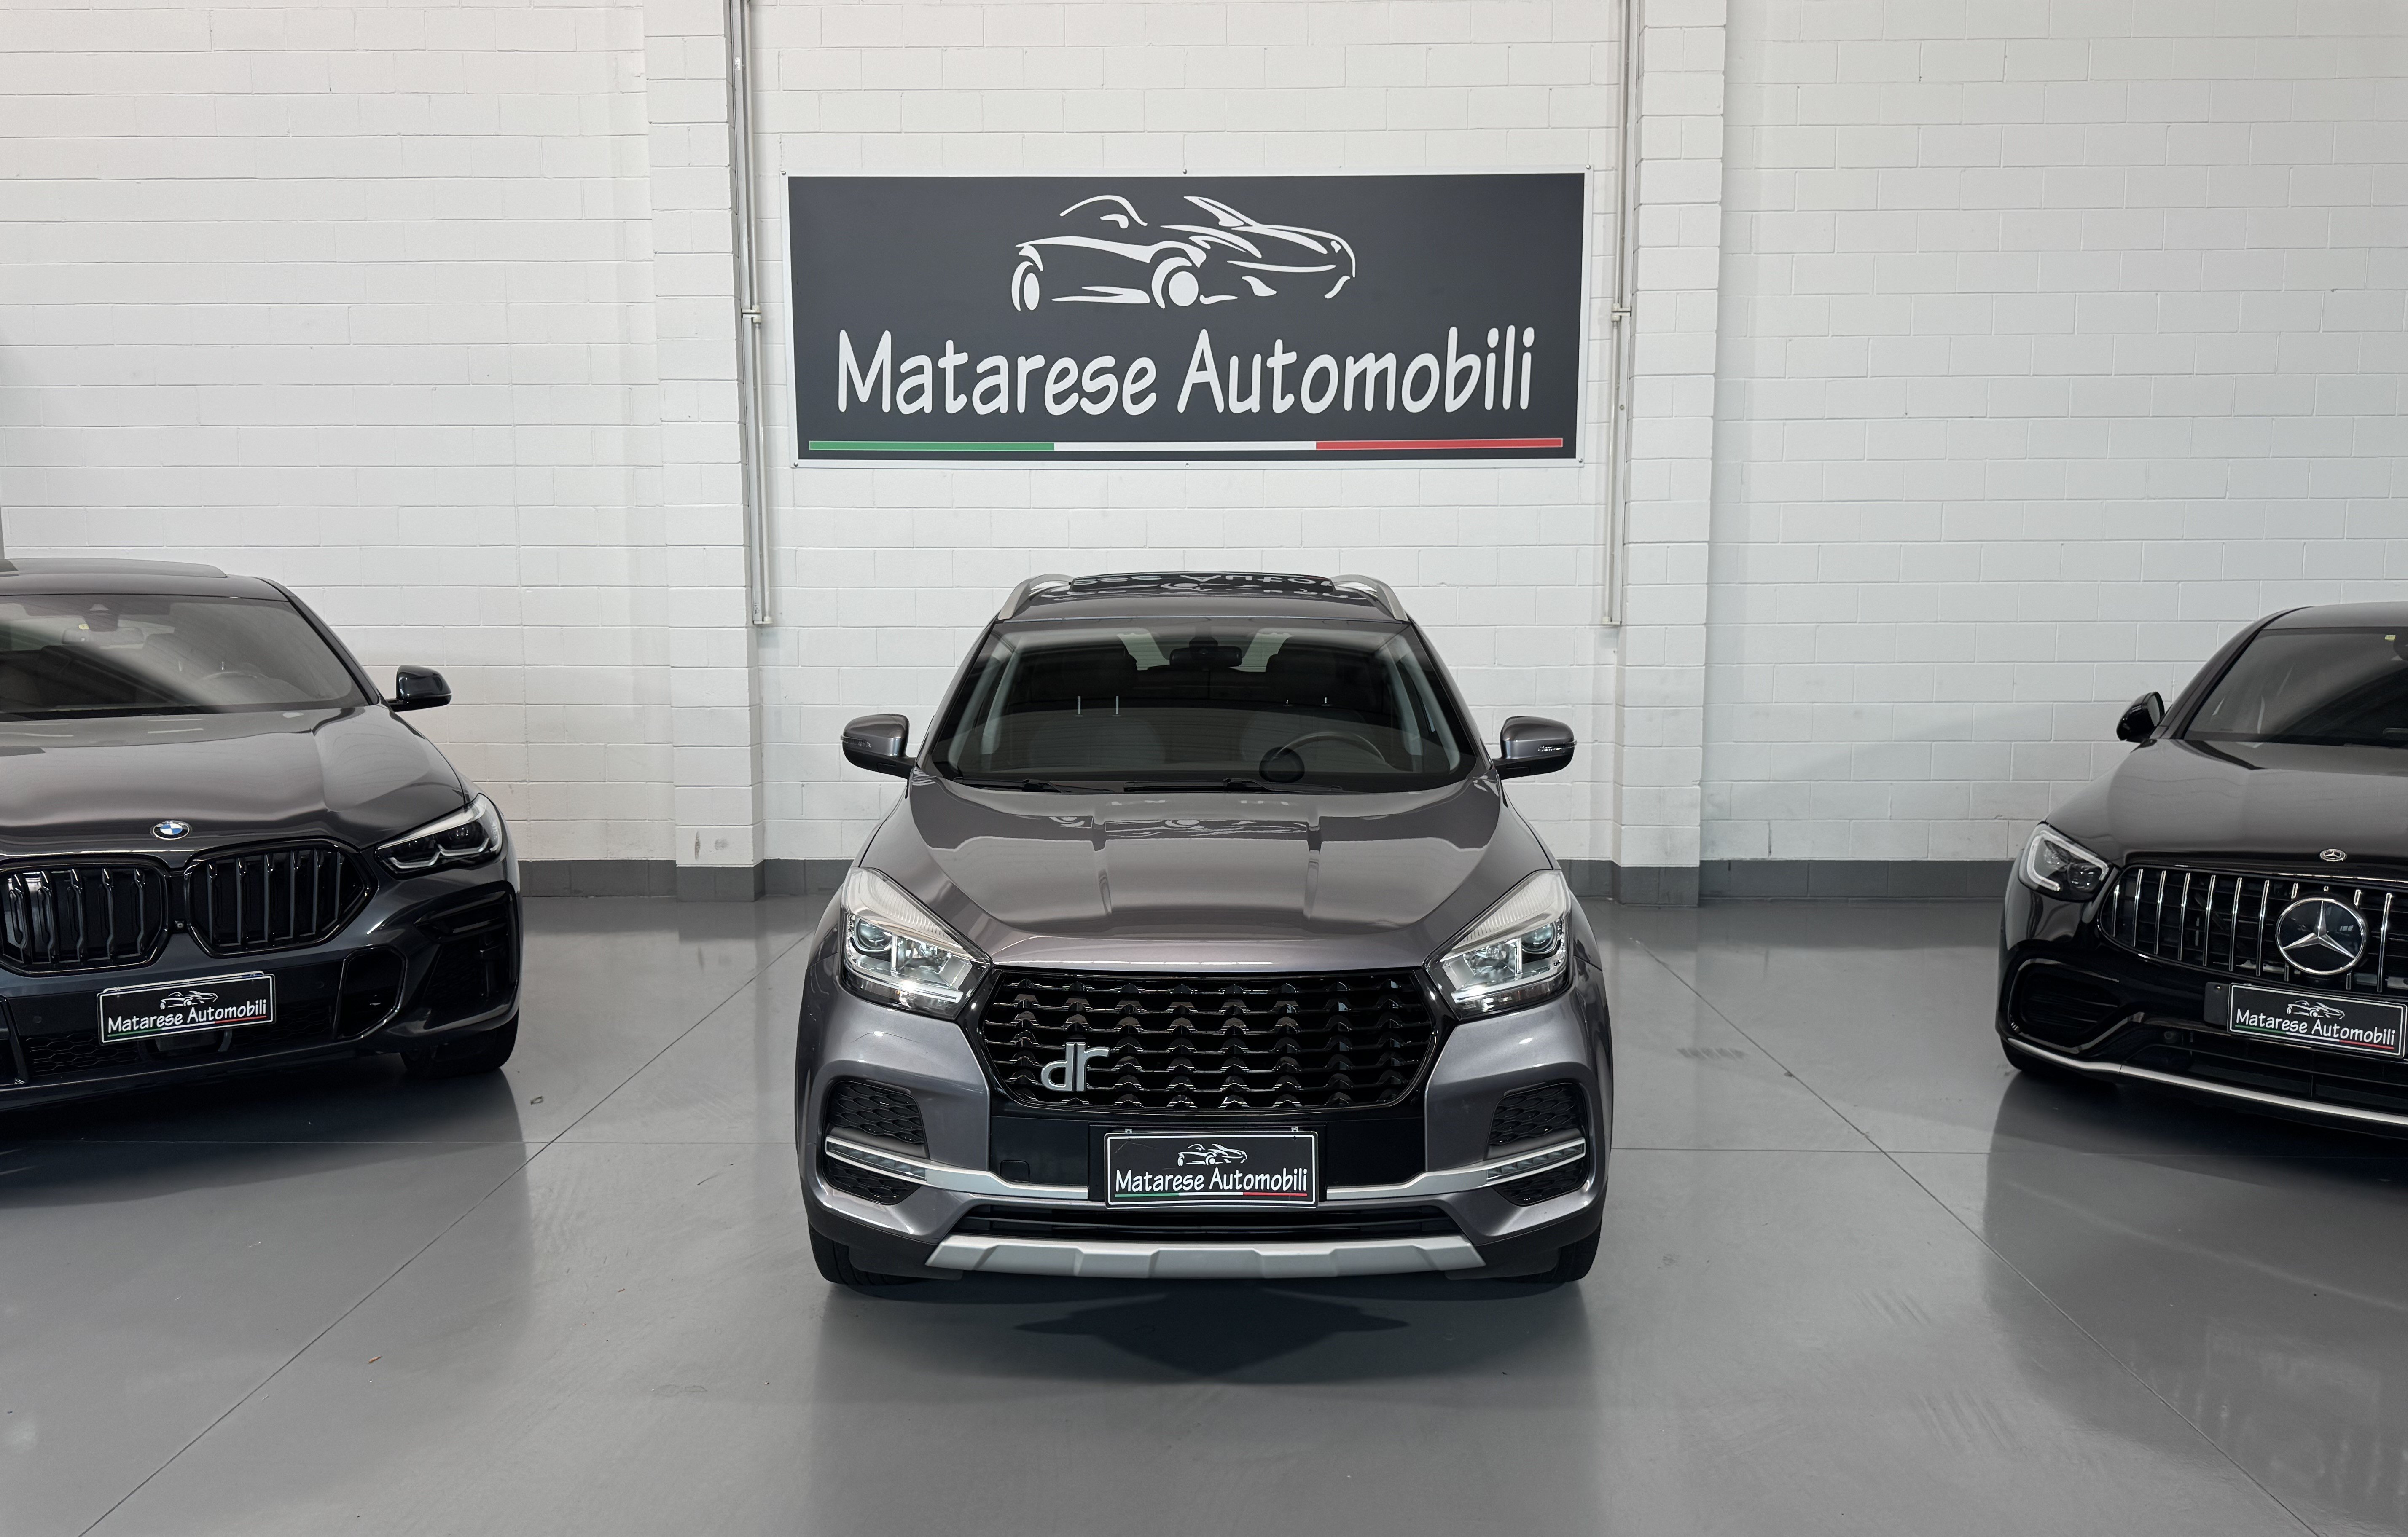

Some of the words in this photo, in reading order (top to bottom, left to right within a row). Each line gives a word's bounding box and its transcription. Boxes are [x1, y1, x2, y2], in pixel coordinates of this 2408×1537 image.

[837, 329, 1157, 416] Matarese
[1177, 325, 1535, 415] Automobili
[108, 1013, 183, 1034] Matarese
[187, 999, 267, 1023] Automobili
[2236, 1008, 2308, 1034] Matarese
[2311, 1019, 2395, 1046] Automobili
[1040, 1042, 1110, 1092] dr
[1115, 1169, 1205, 1193] Matarese
[1209, 1167, 1308, 1191] Automobili
